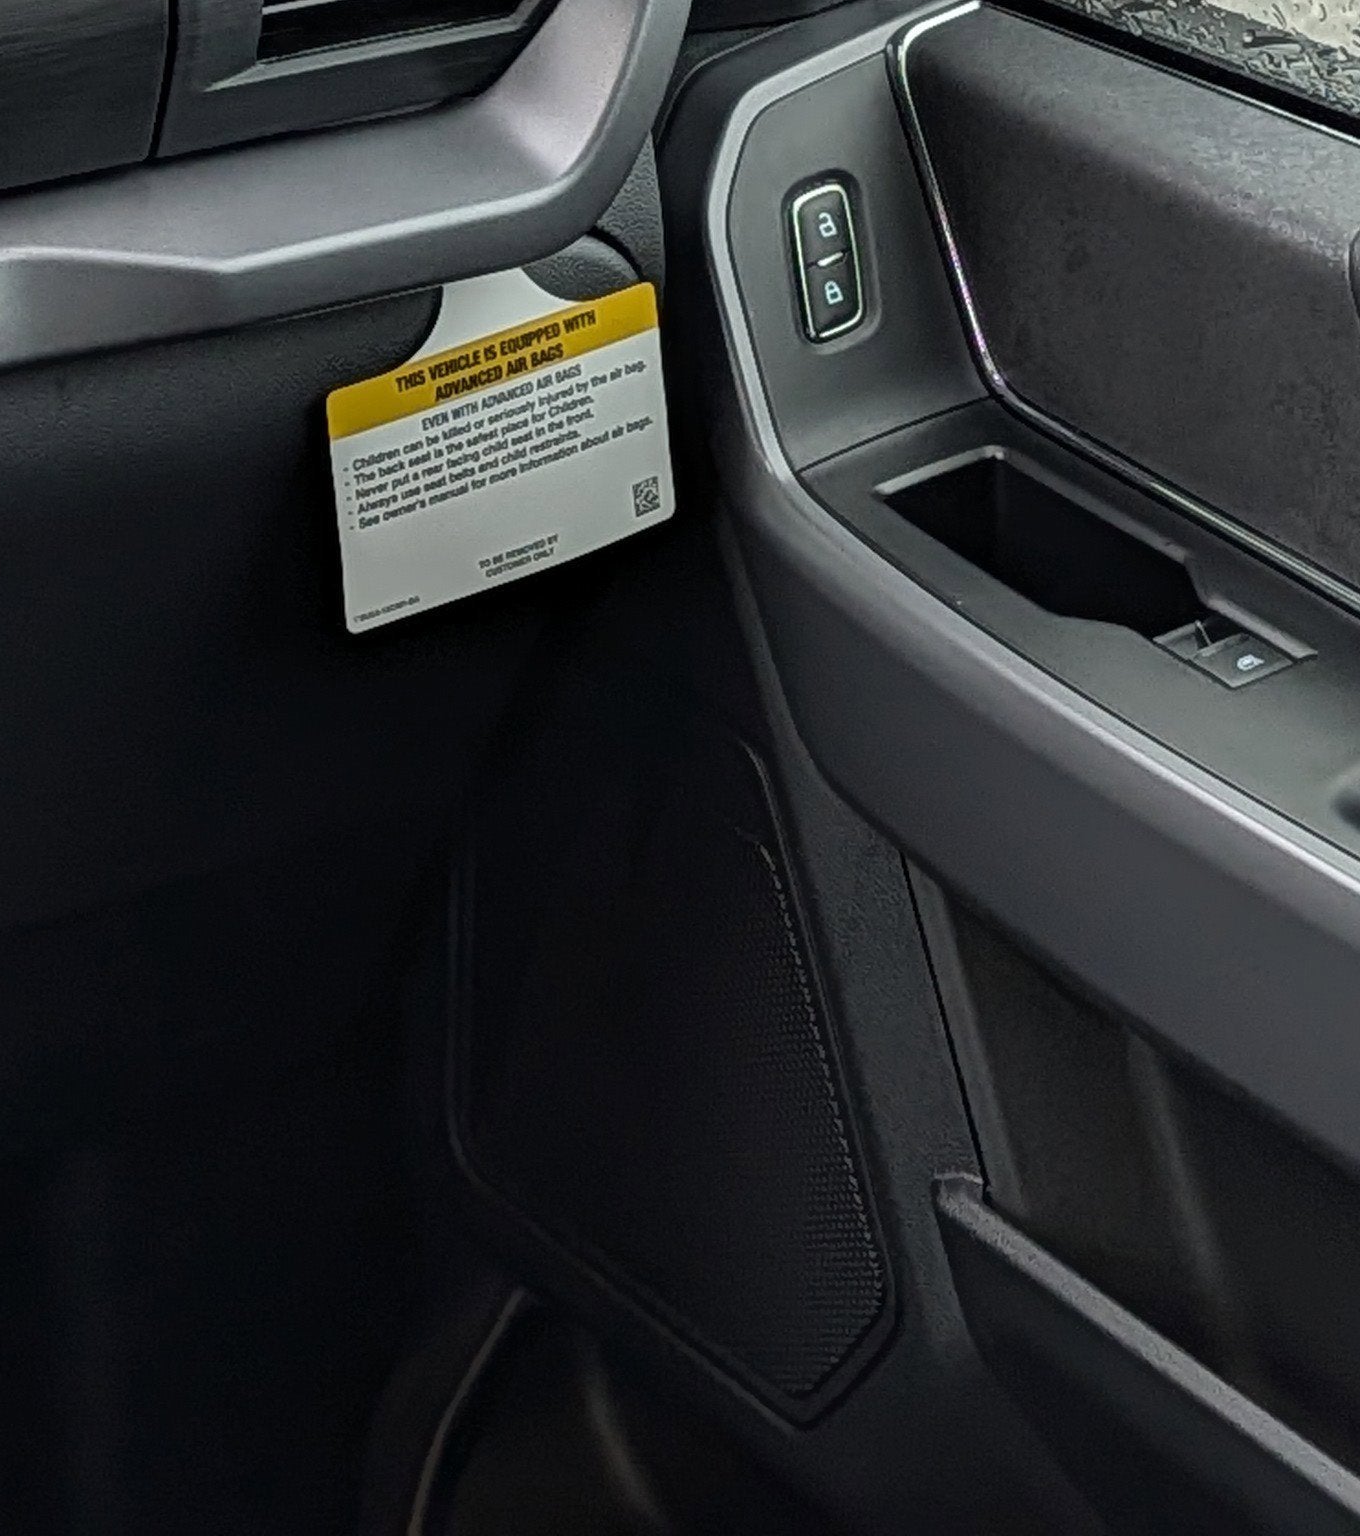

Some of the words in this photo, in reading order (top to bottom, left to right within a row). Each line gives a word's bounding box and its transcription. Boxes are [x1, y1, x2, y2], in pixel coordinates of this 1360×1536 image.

[396, 369, 426, 393] THIS
[428, 349, 481, 381] VEHICLE
[483, 344, 497, 360] IS
[500, 323, 561, 356] EQUIPPED
[563, 310, 597, 334] WITH
[434, 367, 504, 402] ADVANCED
[506, 358, 528, 377] AIR
[530, 343, 564, 366] BAGS
[353, 448, 401, 471] Children
[403, 440, 424, 454] can
[425, 434, 440, 447] be
[442, 421, 472, 441] killed
[473, 418, 485, 429] or
[487, 400, 536, 425] seriously
[538, 385, 574, 407] injured
[575, 381, 589, 393] by
[591, 374, 607, 387] the
[610, 368, 623, 381] air
[625, 360, 647, 375] bag.
[421, 411, 449, 431] EVEN
[451, 399, 480, 420] WITH
[481, 383, 535, 410] ADVANCED
[536, 374, 554, 391] AIR
[555, 364, 582, 384] BAGS
[354, 471, 376, 485] The
[378, 460, 405, 477] back
[408, 450, 432, 468] seat
[434, 448, 444, 459] is
[445, 441, 464, 454] the
[465, 428, 499, 447] safest
[501, 418, 529, 438] place
[531, 412, 546, 423] for
[355, 481, 388, 500] Never
[391, 472, 410, 491] put
[412, 472, 421, 481] a
[421, 463, 444, 478] rear
[446, 450, 480, 470] facing
[482, 439, 509, 457] child
[511, 430, 534, 446] seat
[535, 426, 546, 438] in
[547, 420, 564, 433] the
[566, 408, 595, 426] front.
[357, 494, 399, 516] Always
[401, 486, 421, 500] use
[423, 476, 447, 492] seat
[449, 466, 476, 484] belts
[478, 457, 499, 474] and
[501, 447, 527, 465] child
[530, 430, 582, 455] restraints.
[358, 515, 381, 530] See
[382, 498, 427, 521] owner's
[428, 482, 470, 506] manual
[471, 478, 487, 490] for
[489, 467, 518, 484] more
[519, 444, 579, 474] information
[580, 430, 610, 451] about
[611, 426, 625, 439] air
[626, 416, 653, 434] bags.
[485, 555, 532, 577] CUSTOMER
[533, 547, 555, 561] ONLY
